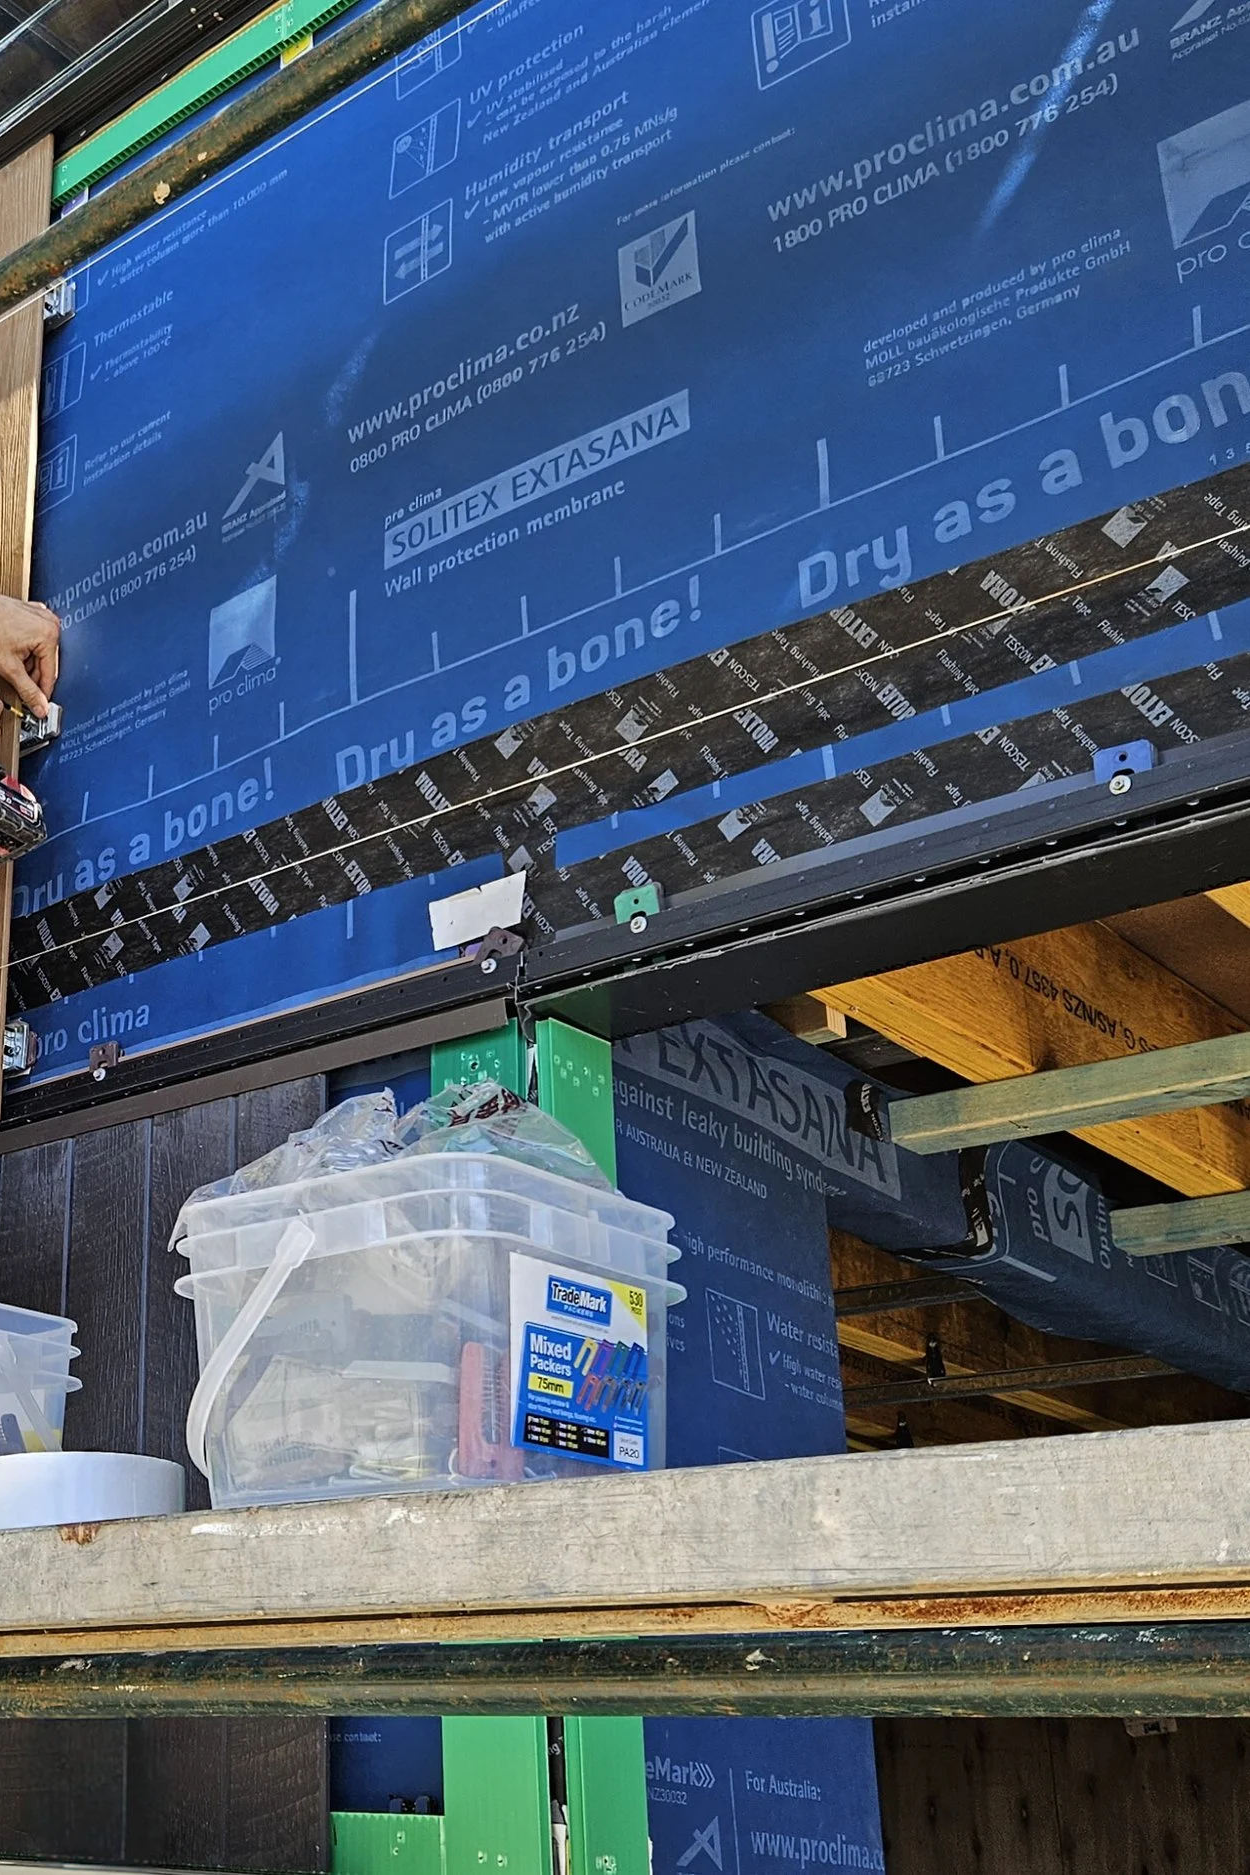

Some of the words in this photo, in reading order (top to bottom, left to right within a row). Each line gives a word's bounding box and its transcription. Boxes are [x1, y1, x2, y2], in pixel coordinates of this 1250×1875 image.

[469, 80, 493, 105] UV
[497, 24, 584, 90] protection
[486, 97, 502, 115] UV
[507, 58, 564, 108] stabilised
[521, 88, 535, 105] be
[539, 55, 588, 95] exposed
[610, 30, 632, 51] the
[565, 73, 588, 96] and
[464, 145, 542, 201] Humidity
[547, 90, 630, 153] transport
[767, 27, 1141, 222] www.proclima.com.au
[483, 187, 509, 208] Low
[512, 162, 556, 195] vapour
[483, 222, 511, 244] with
[514, 199, 551, 232] active
[553, 164, 609, 205] humidity
[611, 128, 673, 171] transport
[772, 218, 823, 253] 1800
[827, 197, 867, 229] PRO
[873, 161, 940, 207] CLIMA
[944, 128, 1009, 174] (1800
[1014, 104, 1060, 137] 776
[1064, 72, 1119, 115] 254)
[492, 192, 530, 224] MVTR
[531, 170, 566, 198] lower
[112, 257, 132, 278] High
[135, 240, 160, 263] water
[162, 208, 208, 244] resistance
[1177, 244, 1227, 284] pro
[863, 314, 929, 354] developed
[932, 301, 957, 322] and
[961, 268, 1026, 310] produced
[1029, 259, 1047, 278] by
[1052, 249, 1076, 272] pro
[1080, 228, 1122, 254] clima
[865, 345, 904, 370] MOLL
[907, 295, 1010, 353] bauökologische
[1014, 265, 1080, 302] Produkte
[1084, 240, 1131, 272] GmbH
[1016, 283, 1081, 320] Germany
[93, 289, 174, 348] Thermostable
[105, 323, 173, 372] Thermostability
[347, 303, 581, 446] www.proclima.co.nz
[350, 445, 388, 474] 0800
[390, 424, 421, 453] PRO
[424, 395, 472, 432] CLIMA
[476, 366, 523, 405] (0800
[528, 349, 561, 376] 776
[565, 321, 607, 356] 254)
[390, 485, 499, 559] SOLITEX
[512, 405, 680, 502] EXTASANA
[1203, 493, 1227, 517] Tape
[384, 509, 405, 530] pro
[407, 486, 442, 512] clima
[797, 525, 912, 610] Dry
[933, 477, 1016, 544] as
[1038, 448, 1083, 496] a
[45, 510, 208, 611] w.proclima.com.au
[385, 566, 422, 599] Wall
[428, 525, 520, 580] protection
[526, 479, 626, 536] membrane
[1046, 541, 1084, 580] Flashing
[74, 595, 108, 624] CLIMA
[110, 575, 142, 606] (1800
[145, 563, 167, 584] 776
[169, 544, 197, 573] 254)
[431, 695, 487, 749] as
[503, 674, 531, 713] a
[548, 574, 702, 693] bone!
[936, 648, 964, 682] Flashing
[1003, 634, 1034, 665] TESCON
[727, 657, 761, 692] TESCON
[208, 689, 233, 716] pro
[1052, 707, 1074, 731] Tape
[998, 736, 1032, 772] TESCON
[74, 847, 117, 891] as
[128, 830, 150, 863] a
[164, 757, 275, 852] bone!
[78, 1004, 150, 1044] clima
[625, 1123, 681, 1162] AUSTRALIA
[683, 1150, 694, 1167] &
[696, 1155, 722, 1179] NEW
[724, 1166, 767, 1200] ZEALAND
[682, 1100, 728, 1148] leaky
[733, 1129, 793, 1182] building
[707, 1244, 774, 1282] performance
[551, 1282, 607, 1314] TradeMark
[629, 1290, 643, 1308] 530
[530, 1332, 572, 1361] Mixed
[766, 1311, 803, 1342] Water
[530, 1355, 572, 1377] Packers
[537, 1376, 565, 1394] 75mm
[782, 1353, 802, 1376] High
[804, 1364, 825, 1384] water
[618, 1446, 640, 1459] PA20
[745, 1770, 766, 1793] For
[768, 1775, 821, 1802] Australia:
